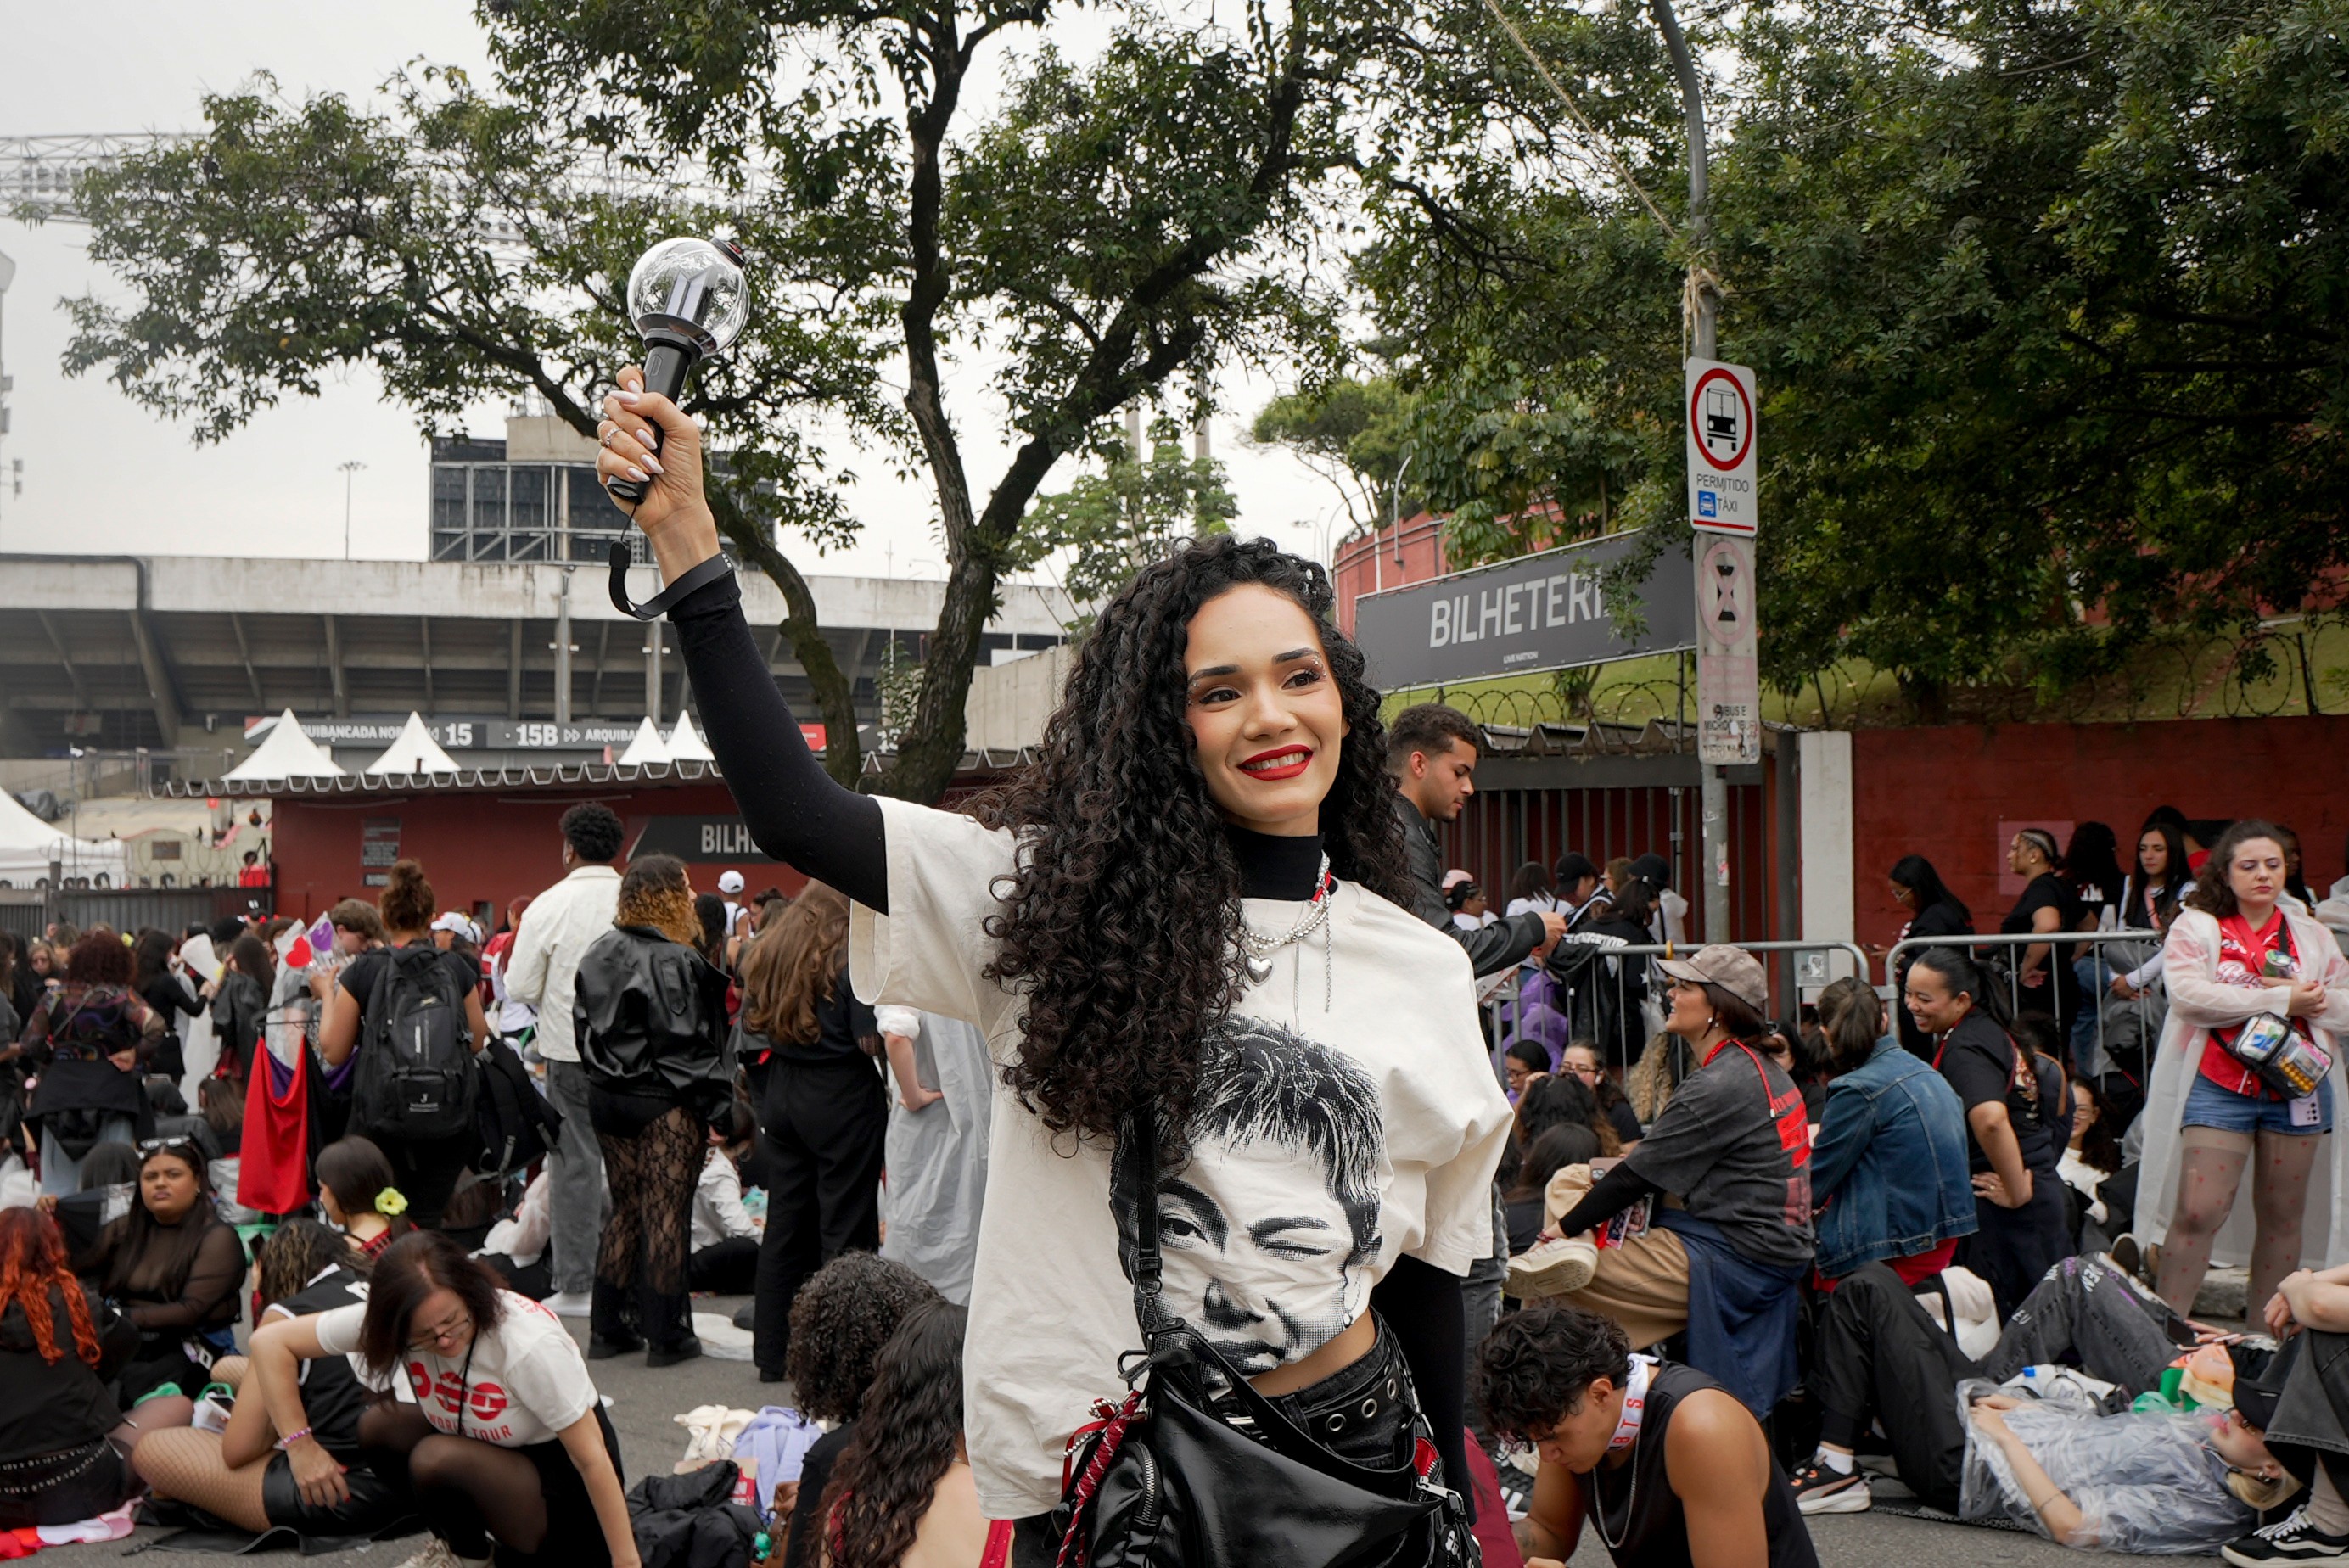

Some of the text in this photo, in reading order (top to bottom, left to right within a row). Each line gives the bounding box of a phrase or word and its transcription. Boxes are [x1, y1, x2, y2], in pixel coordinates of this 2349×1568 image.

[1696, 473, 1750, 493] PERMITIDO
[1429, 568, 1611, 648] BILHETERI
[446, 723, 473, 747] 15
[516, 724, 558, 747] 15B
[1613, 1398, 1644, 1444] BTS
[472, 1425, 512, 1442] TOUR
